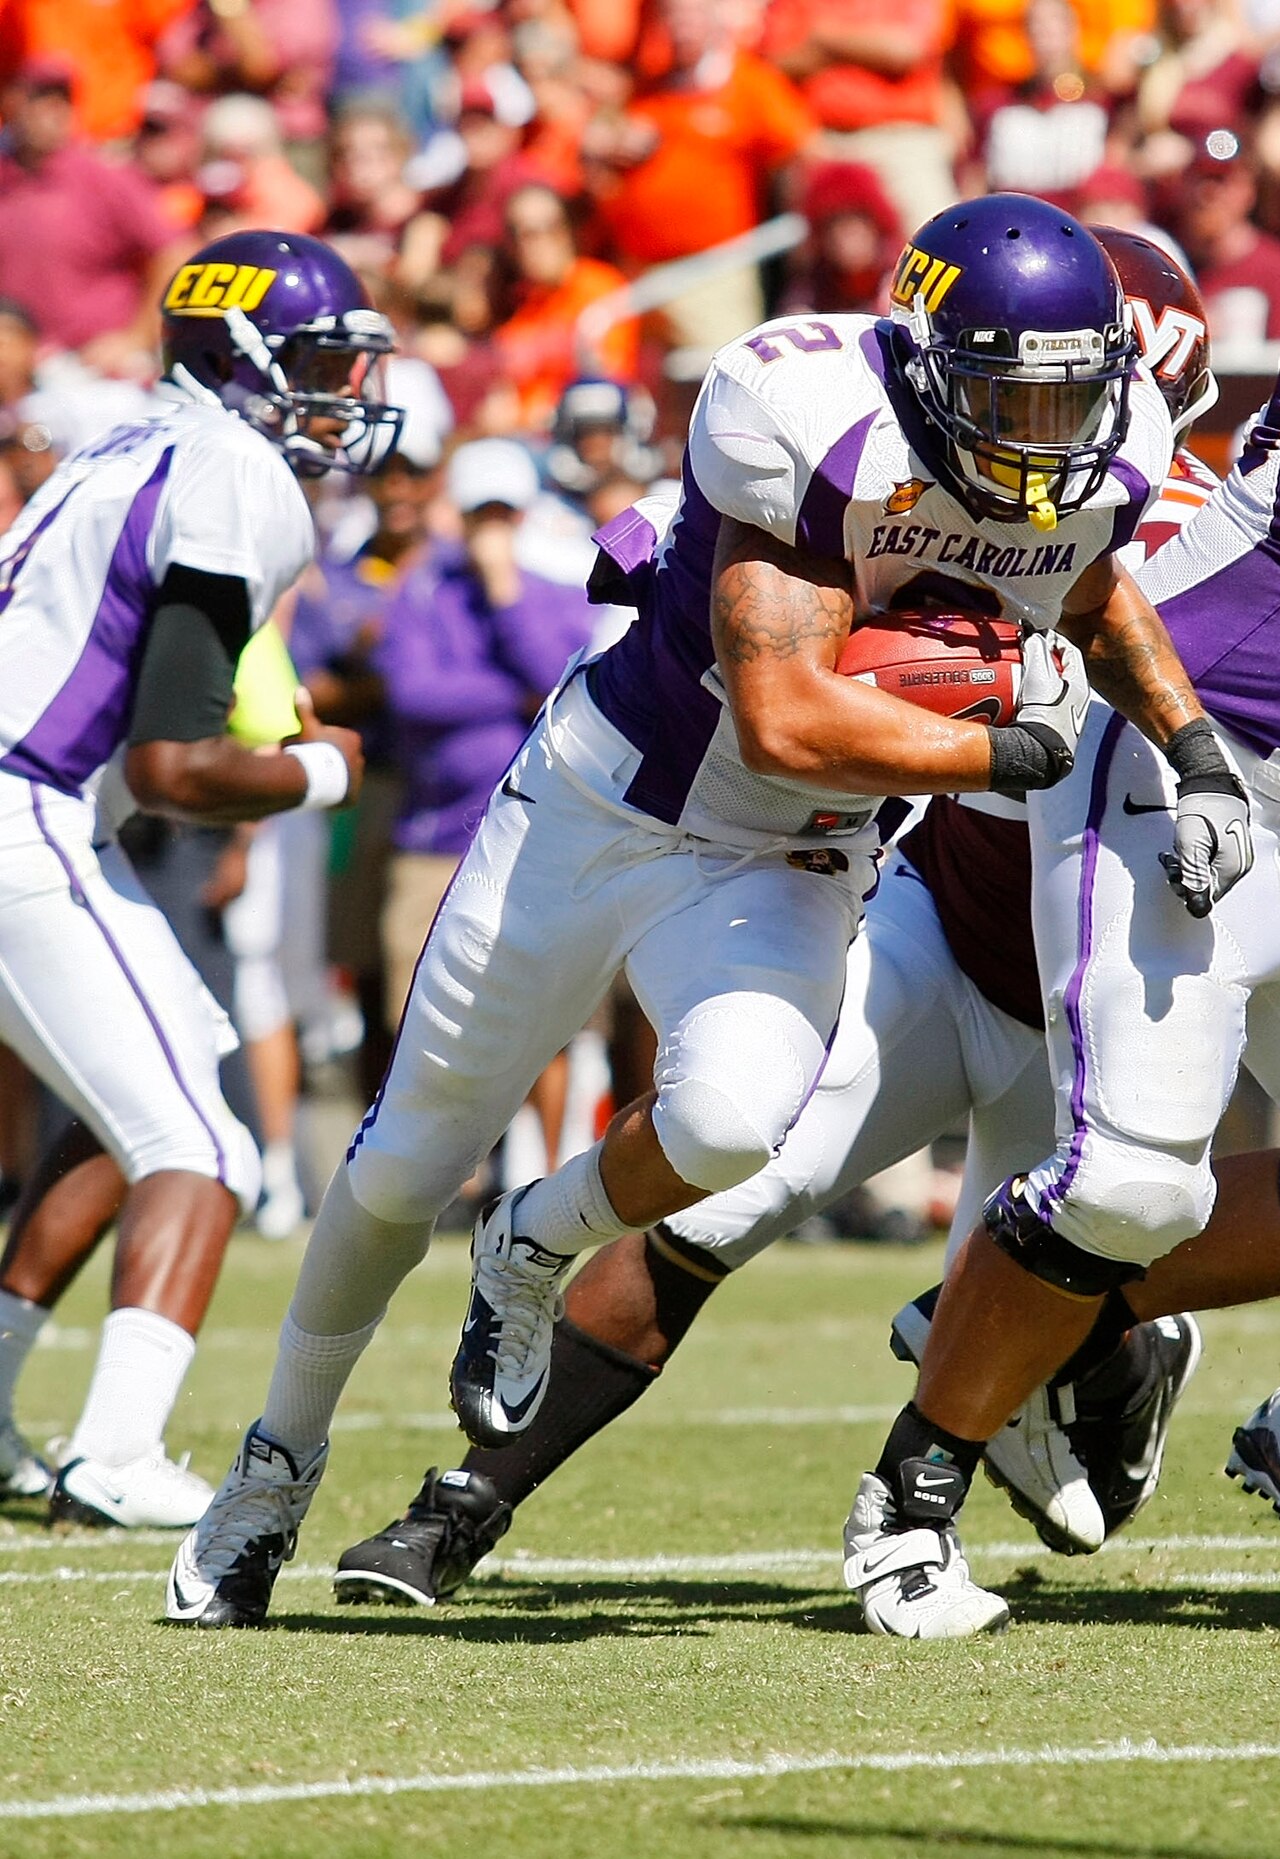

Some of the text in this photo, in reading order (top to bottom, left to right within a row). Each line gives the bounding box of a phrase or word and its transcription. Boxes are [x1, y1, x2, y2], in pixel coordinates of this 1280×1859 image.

[164, 262, 277, 313] ECU
[893, 243, 962, 313] CU
[743, 321, 844, 367] 2
[1124, 294, 1206, 380] VT
[865, 525, 1077, 578] EAST CAROLINA
